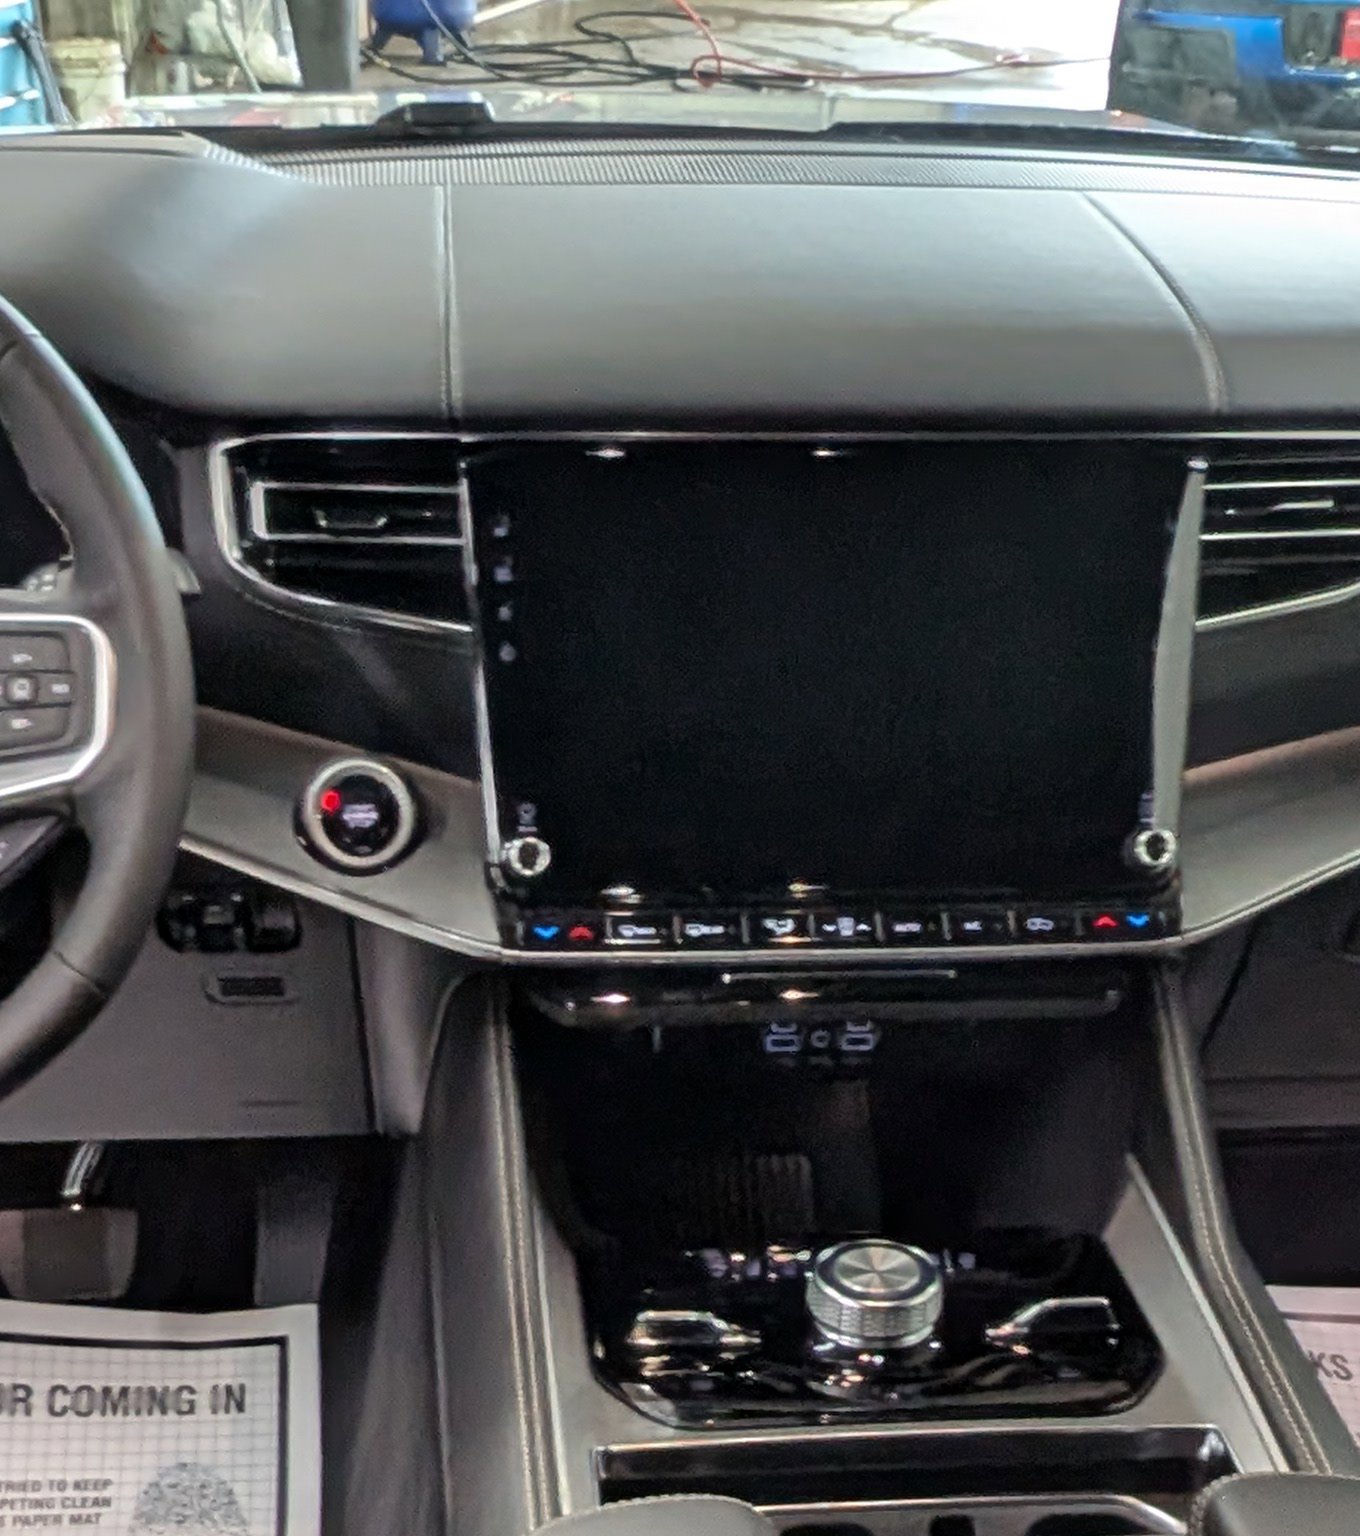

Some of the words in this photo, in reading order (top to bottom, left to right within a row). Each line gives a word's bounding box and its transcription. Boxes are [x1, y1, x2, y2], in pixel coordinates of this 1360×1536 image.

[47, 1382, 197, 1418] COMING
[209, 1382, 247, 1415] IN
[48, 1479, 68, 1493] TO
[72, 1478, 113, 1492] KEEP
[60, 1496, 112, 1510] CLEAN
[68, 1512, 102, 1525] MAT
